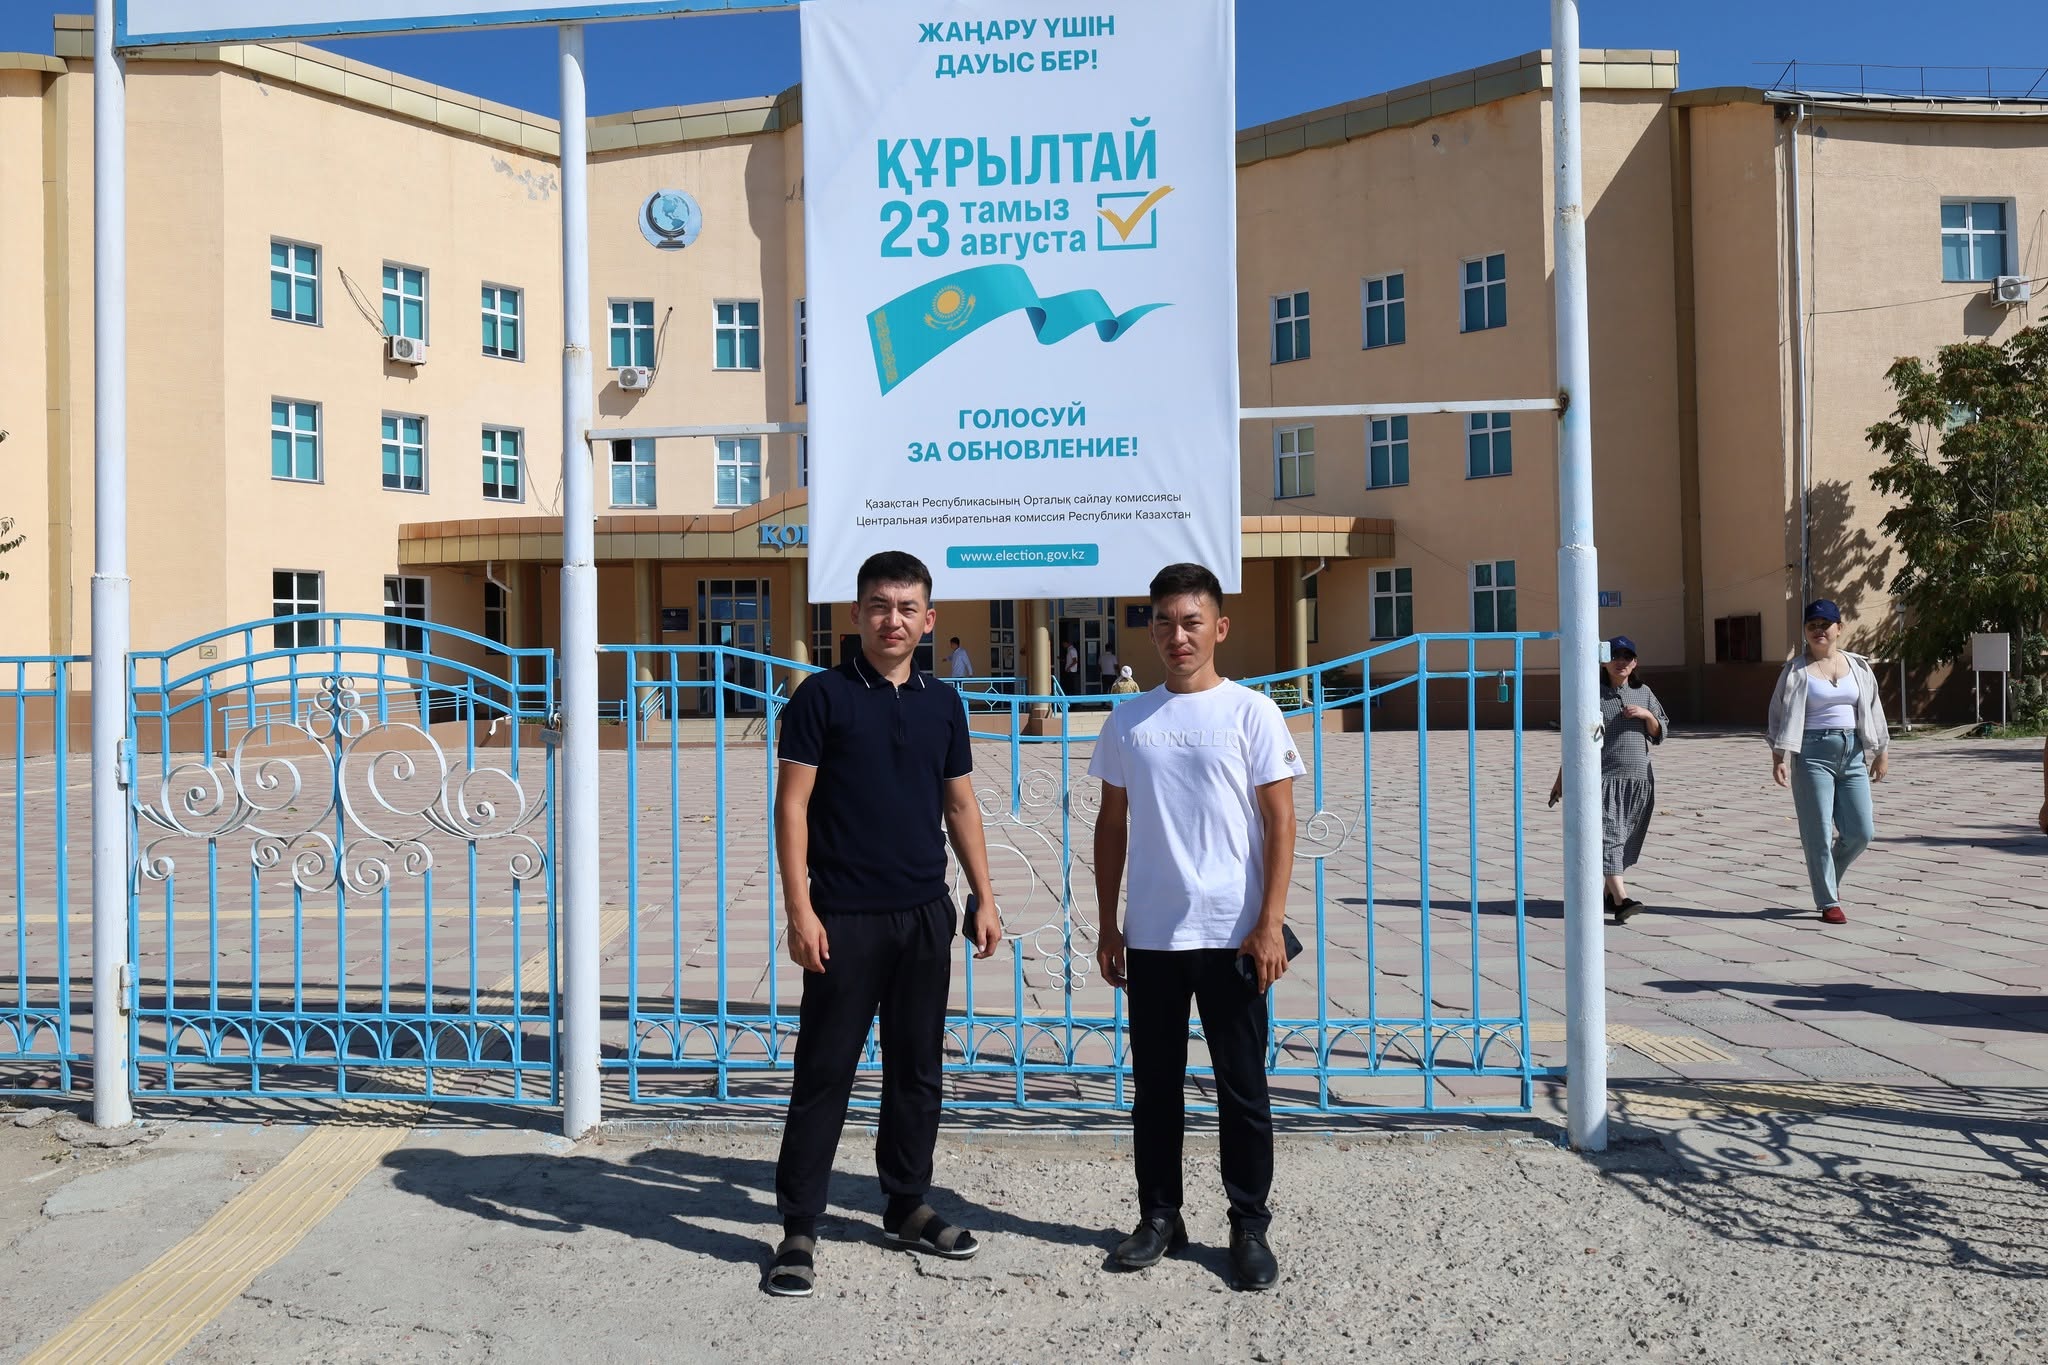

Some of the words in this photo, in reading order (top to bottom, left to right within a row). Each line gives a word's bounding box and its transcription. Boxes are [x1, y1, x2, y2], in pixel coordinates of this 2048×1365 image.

[919, 19, 1037, 44] ЖАҢАРУ
[1044, 16, 1114, 38] ҮШІН
[936, 52, 1034, 78] ДАУЫС
[1042, 50, 1097, 71] БЕР!
[878, 117, 1156, 195] ҚҰРЫЛТАЙ
[880, 200, 949, 257] 23
[960, 199, 1069, 223] тамыз
[961, 230, 1086, 260] августа
[960, 401, 1085, 429] ГОЛОСУЙ
[908, 442, 941, 462] ЗА
[948, 437, 1137, 461] ОБНОВЛЕНИЕ!
[865, 498, 919, 511] Қазақстан
[922, 496, 1021, 510] Республикасының
[1023, 494, 1072, 507] Орталық
[1073, 493, 1113, 506] сайлау
[1115, 493, 1182, 503] комиссиясы
[856, 516, 928, 528] Центральная
[930, 513, 1012, 526] избирательная
[1014, 513, 1066, 523] комиссия
[1068, 510, 1132, 523] Республики
[1135, 509, 1191, 520] Казахстан
[960, 548, 1085, 564] www.election.gov.kz
[1131, 730, 1240, 748] MONCLER
